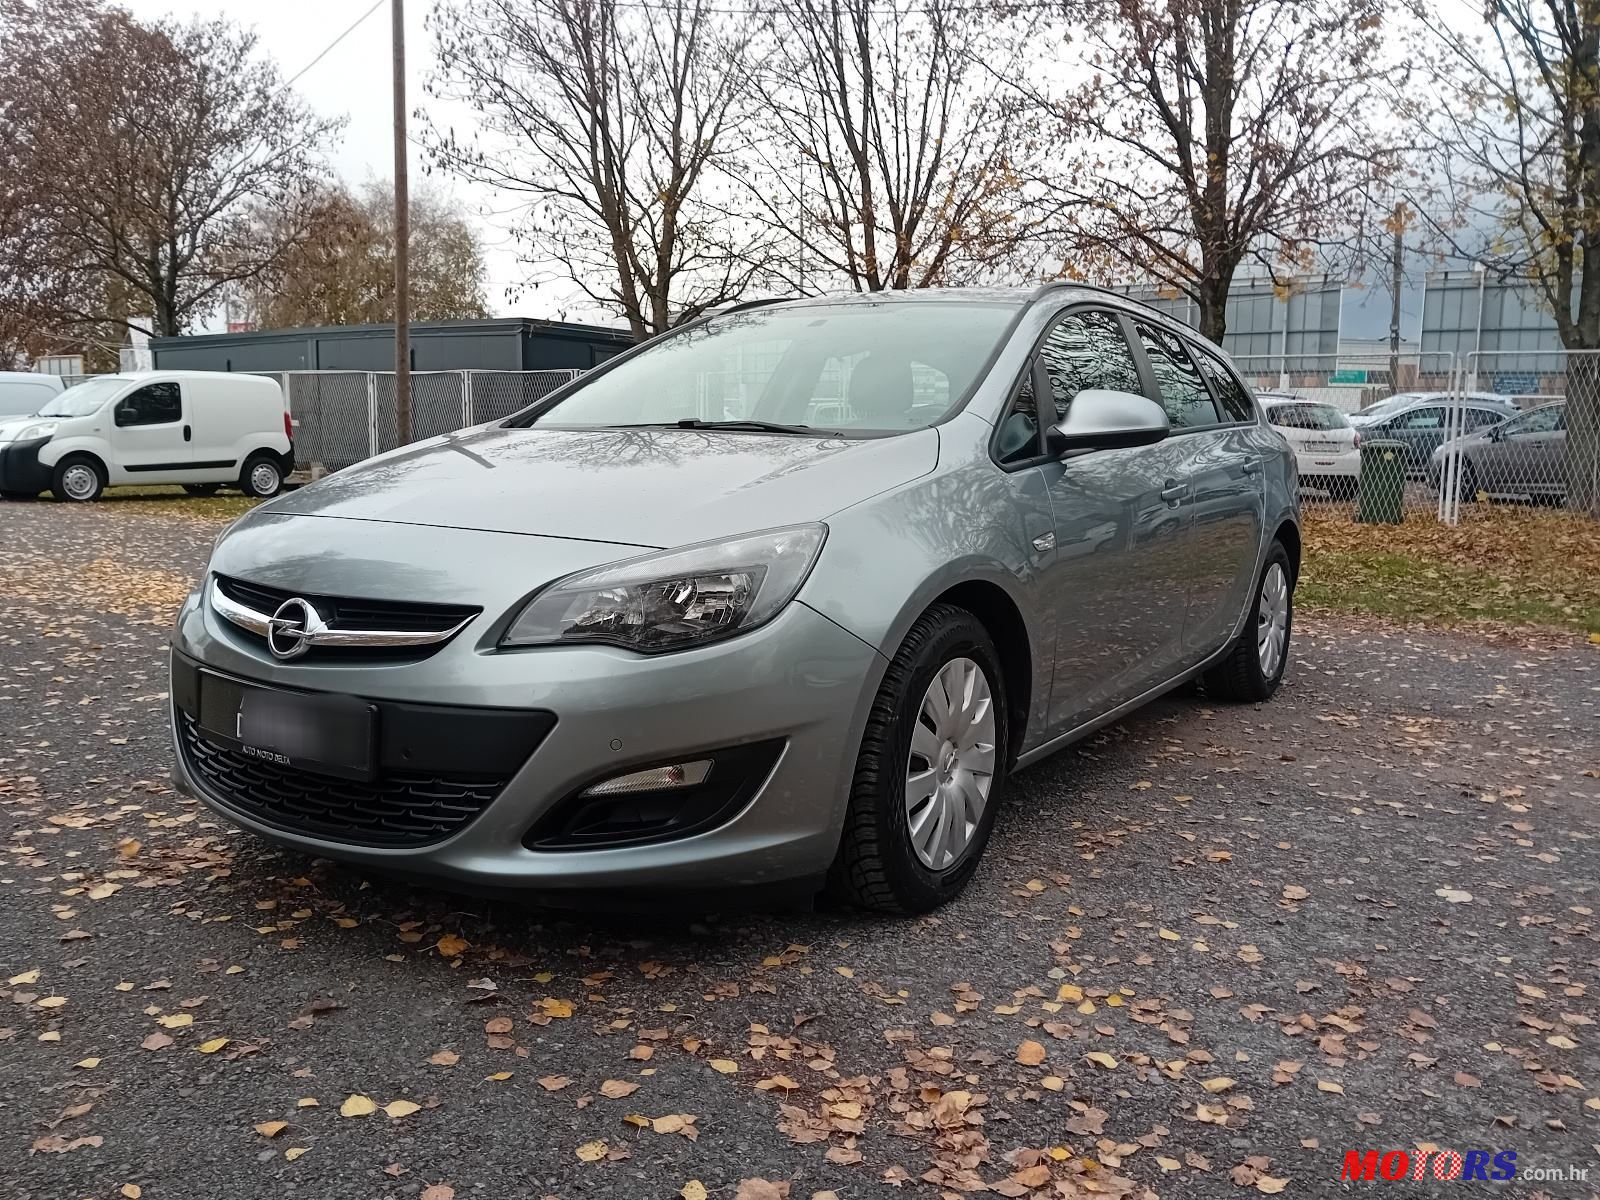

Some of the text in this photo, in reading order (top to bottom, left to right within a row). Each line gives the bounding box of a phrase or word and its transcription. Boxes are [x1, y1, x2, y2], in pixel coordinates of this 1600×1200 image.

[241, 745, 291, 765] AUTO MOTO DELTA
